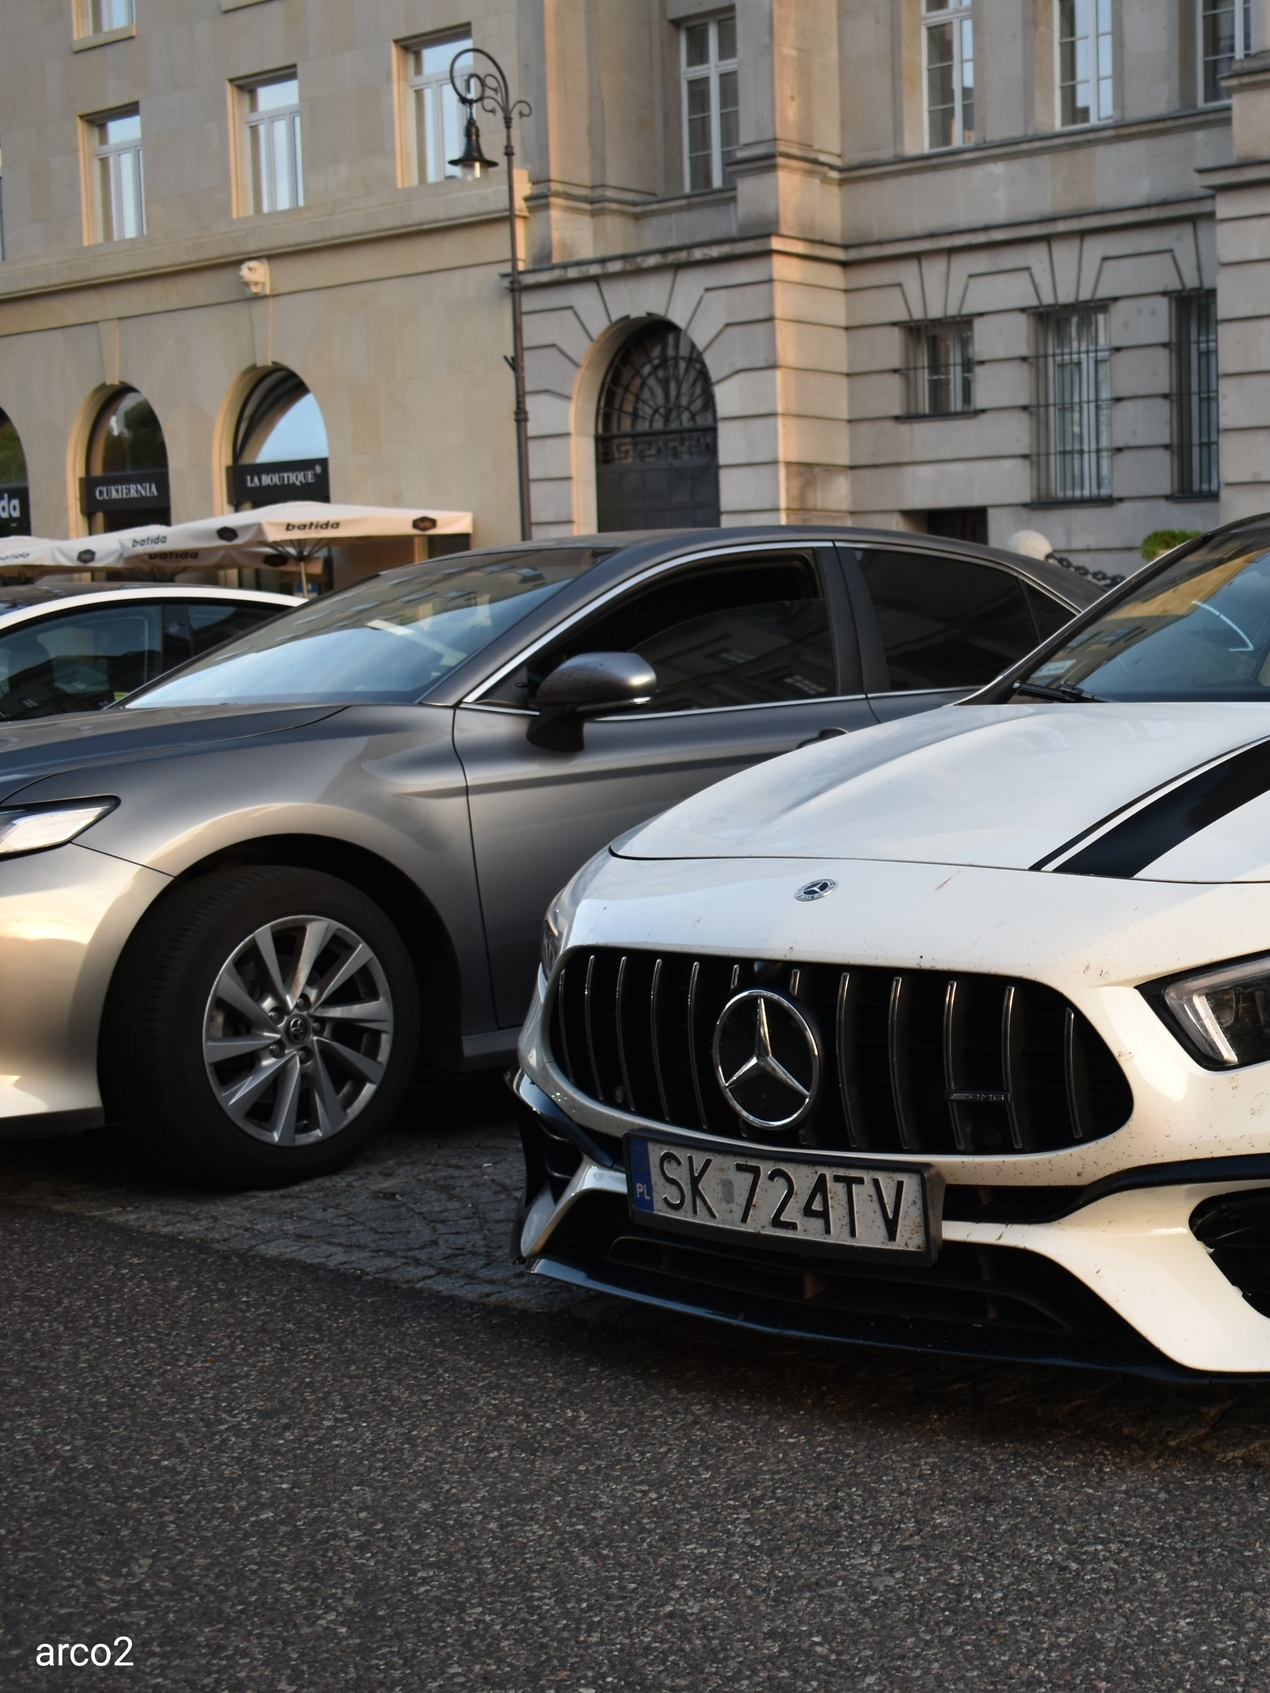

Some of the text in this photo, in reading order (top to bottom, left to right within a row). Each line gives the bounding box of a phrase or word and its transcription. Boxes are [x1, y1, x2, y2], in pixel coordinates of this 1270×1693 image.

[247, 470, 316, 487] LA BOUTIQUE
[95, 483, 158, 500] CUKIERNIA
[285, 520, 340, 531] batida
[132, 535, 167, 547] batida
[636, 1182, 651, 1200] PL
[659, 1150, 905, 1242] SK 724TV
